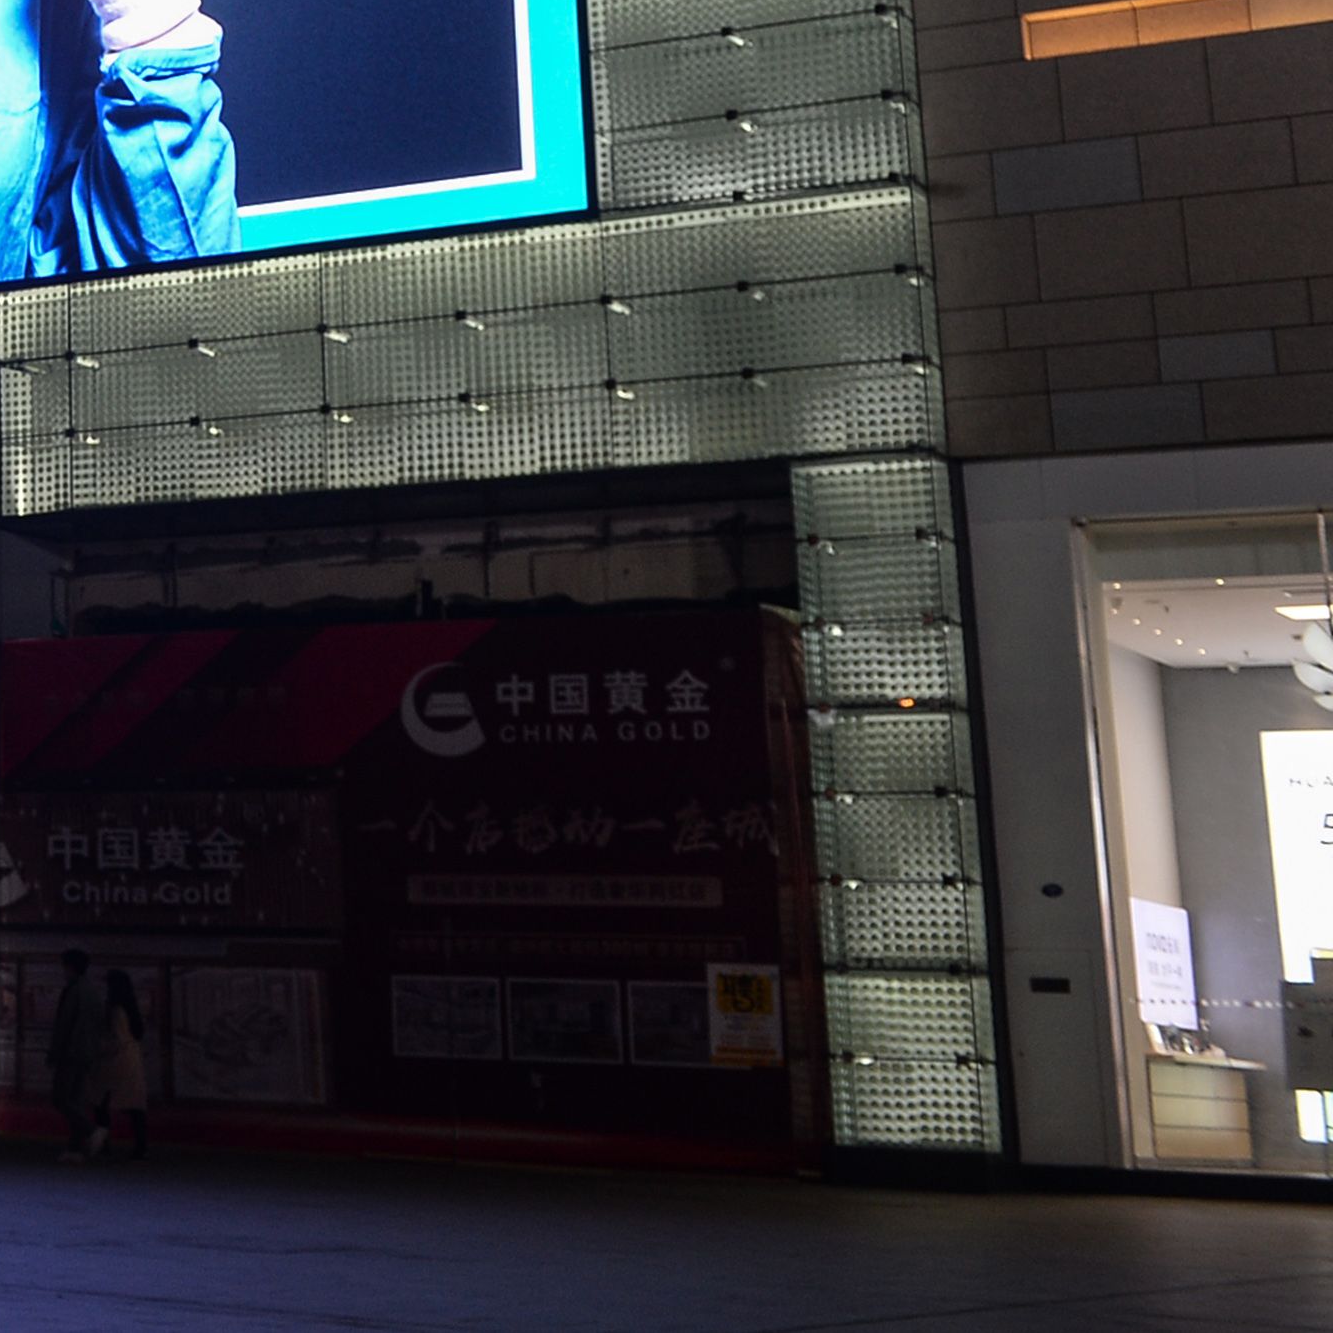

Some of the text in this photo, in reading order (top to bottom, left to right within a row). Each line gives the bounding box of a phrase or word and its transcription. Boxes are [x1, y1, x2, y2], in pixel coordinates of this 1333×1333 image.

[495, 668, 711, 717] 中国黄金
[498, 720, 711, 745] CHINA GOLD
[47, 825, 245, 871] 中国黄金
[62, 880, 232, 906] China Gold
